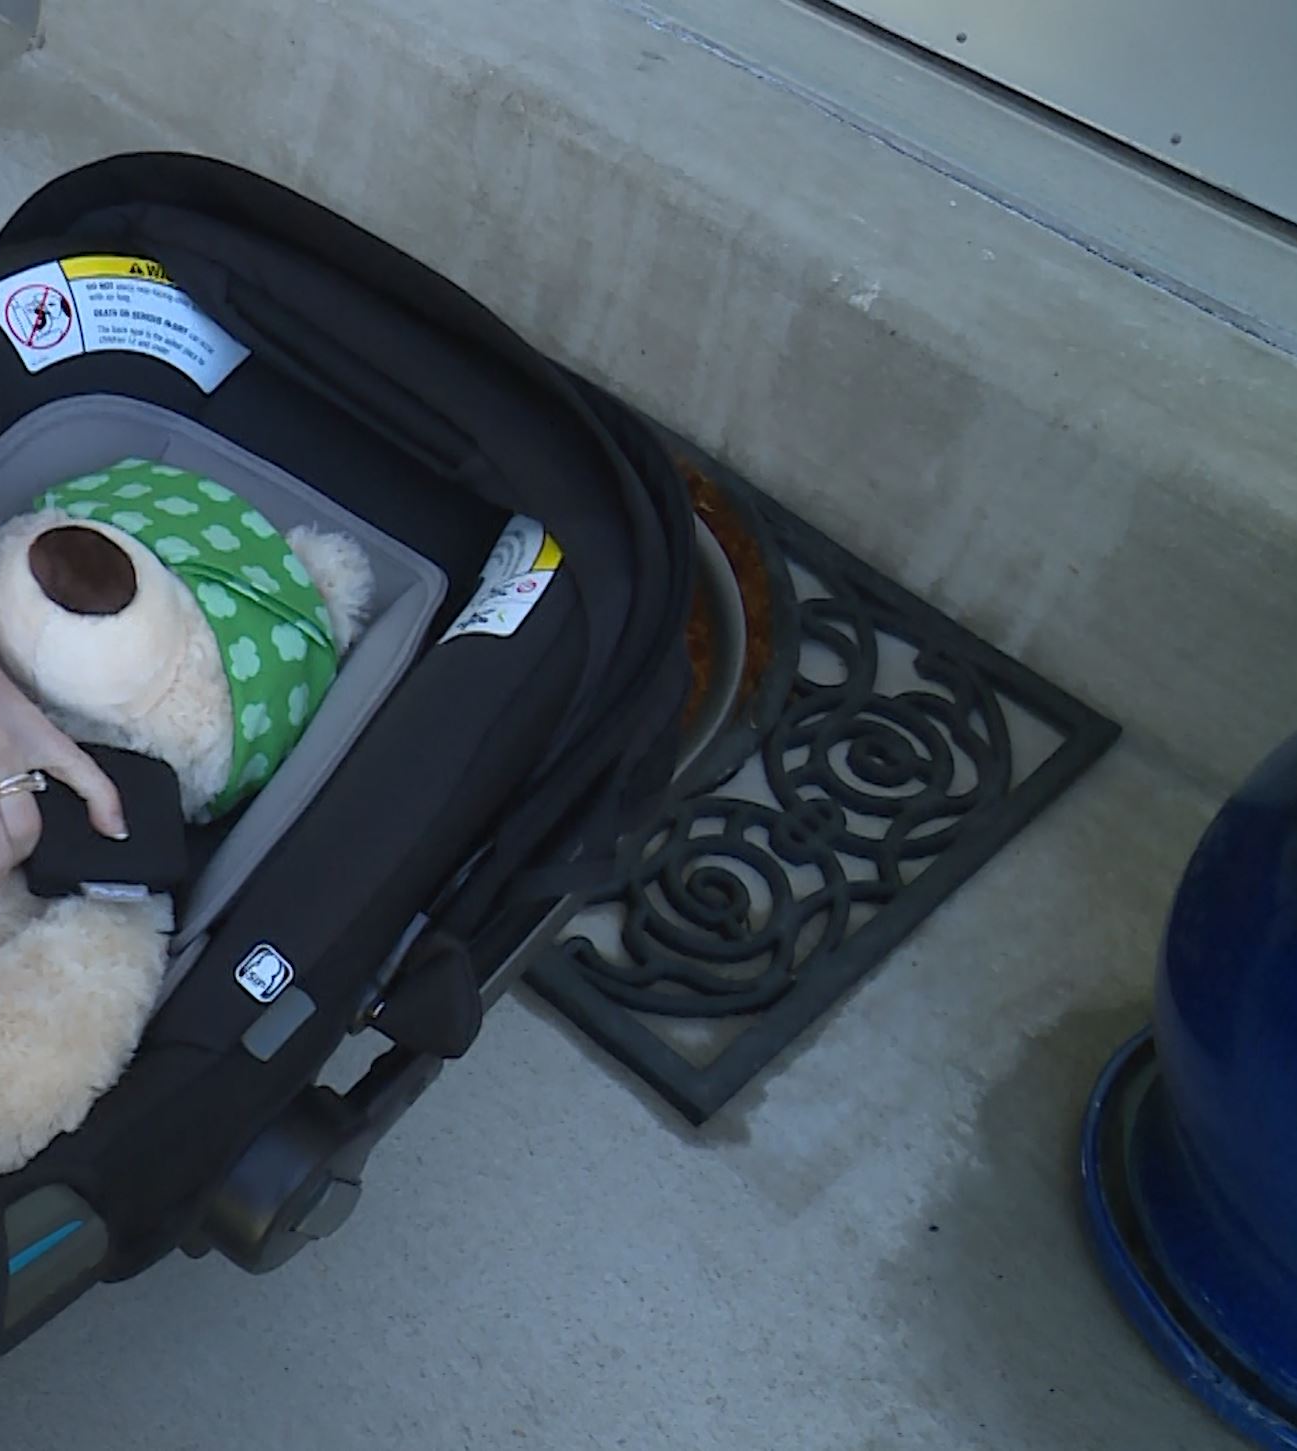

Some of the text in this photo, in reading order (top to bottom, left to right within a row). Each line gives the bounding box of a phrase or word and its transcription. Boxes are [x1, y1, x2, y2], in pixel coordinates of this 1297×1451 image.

[99, 281, 114, 290] NOT
[93, 308, 118, 317] DEATH
[119, 308, 130, 317] OR
[132, 311, 163, 325] SERIOUS
[164, 319, 188, 335] INJURY
[97, 324, 110, 333] The
